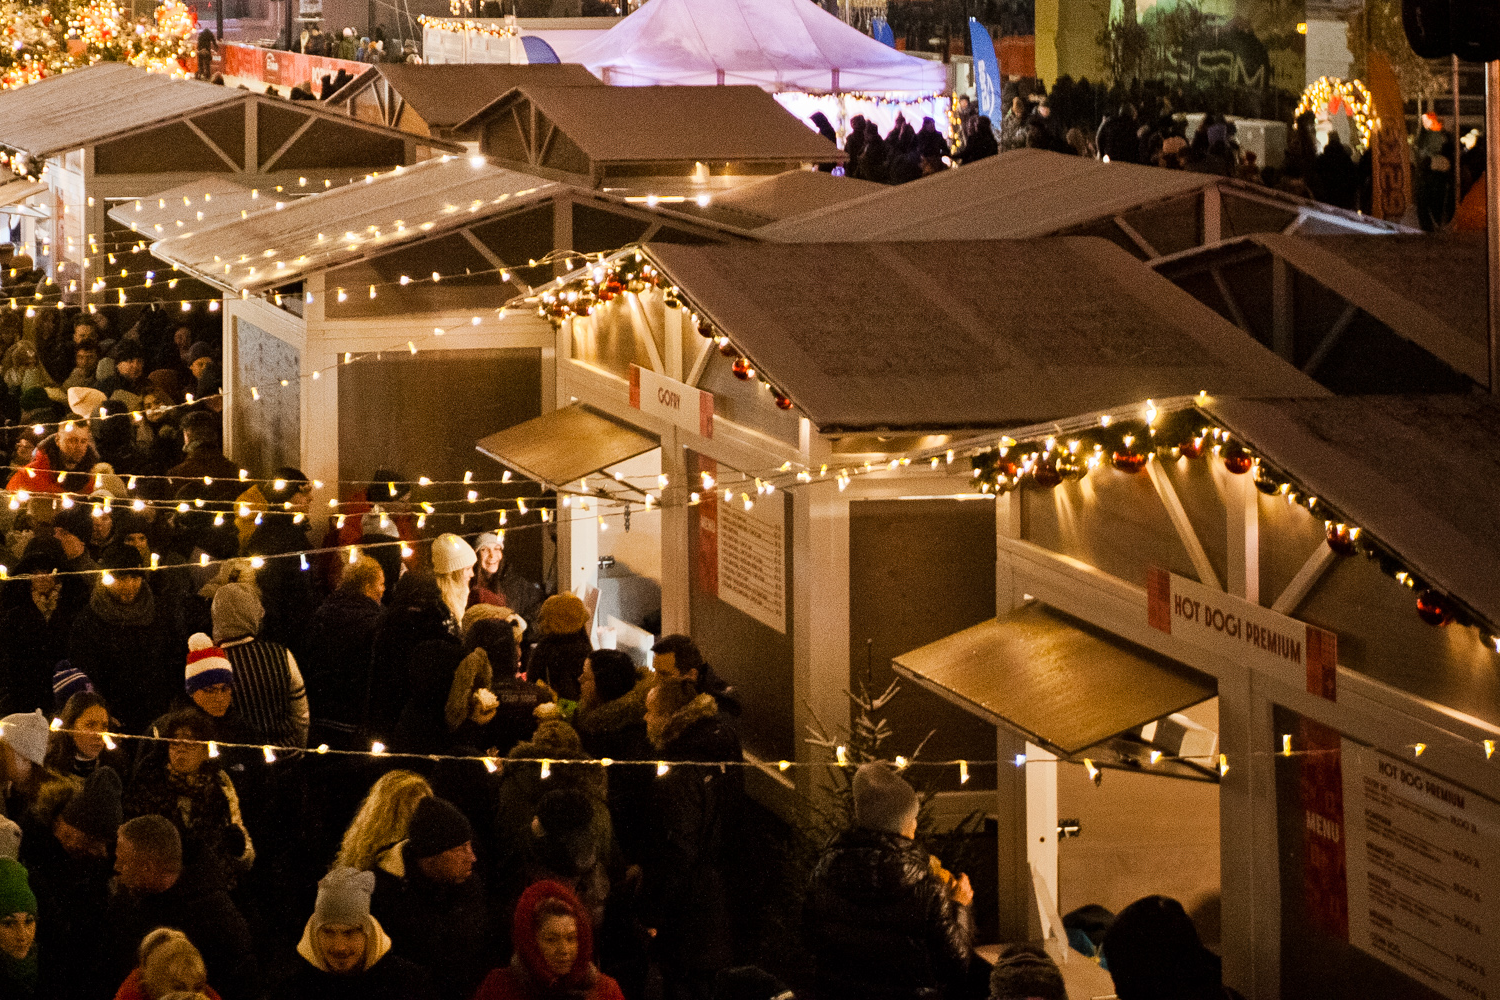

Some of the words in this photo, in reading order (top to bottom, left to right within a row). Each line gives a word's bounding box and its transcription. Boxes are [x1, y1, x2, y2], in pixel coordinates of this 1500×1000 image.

[1174, 593, 1200, 622] HOT
[1205, 604, 1242, 639] DOGI
[1246, 621, 1302, 664] PREMIUM
[1378, 759, 1398, 780] HOT
[1400, 768, 1423, 791] DOG
[1425, 780, 1465, 809] PREMIUM
[1306, 809, 1340, 843] MENU
